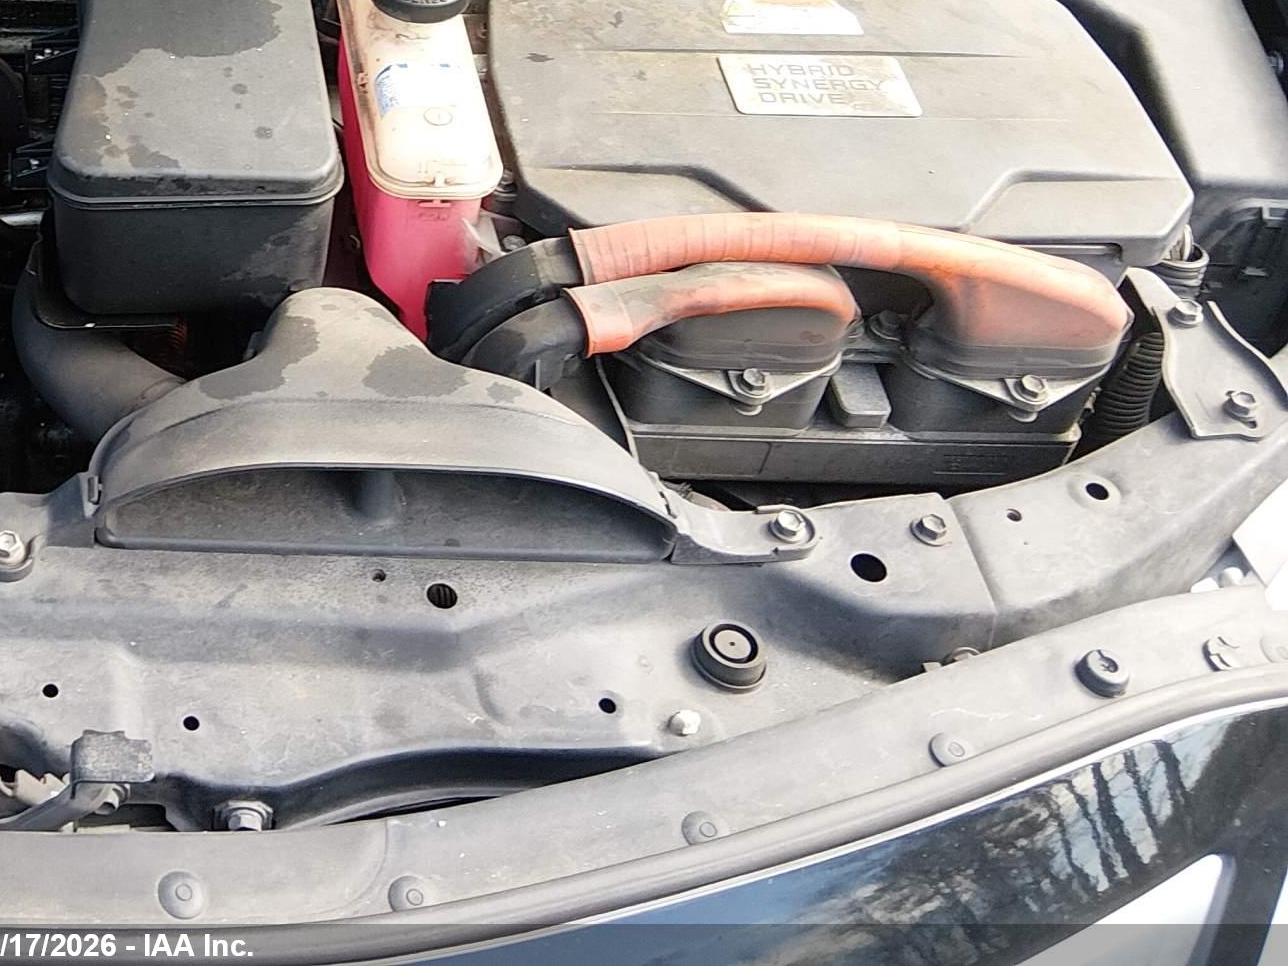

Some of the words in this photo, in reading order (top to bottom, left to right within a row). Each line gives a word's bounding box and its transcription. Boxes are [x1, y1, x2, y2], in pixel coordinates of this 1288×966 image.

[747, 63, 854, 77] HYBRID
[752, 78, 882, 91] SYNERGY
[759, 92, 847, 104] DRIVE
